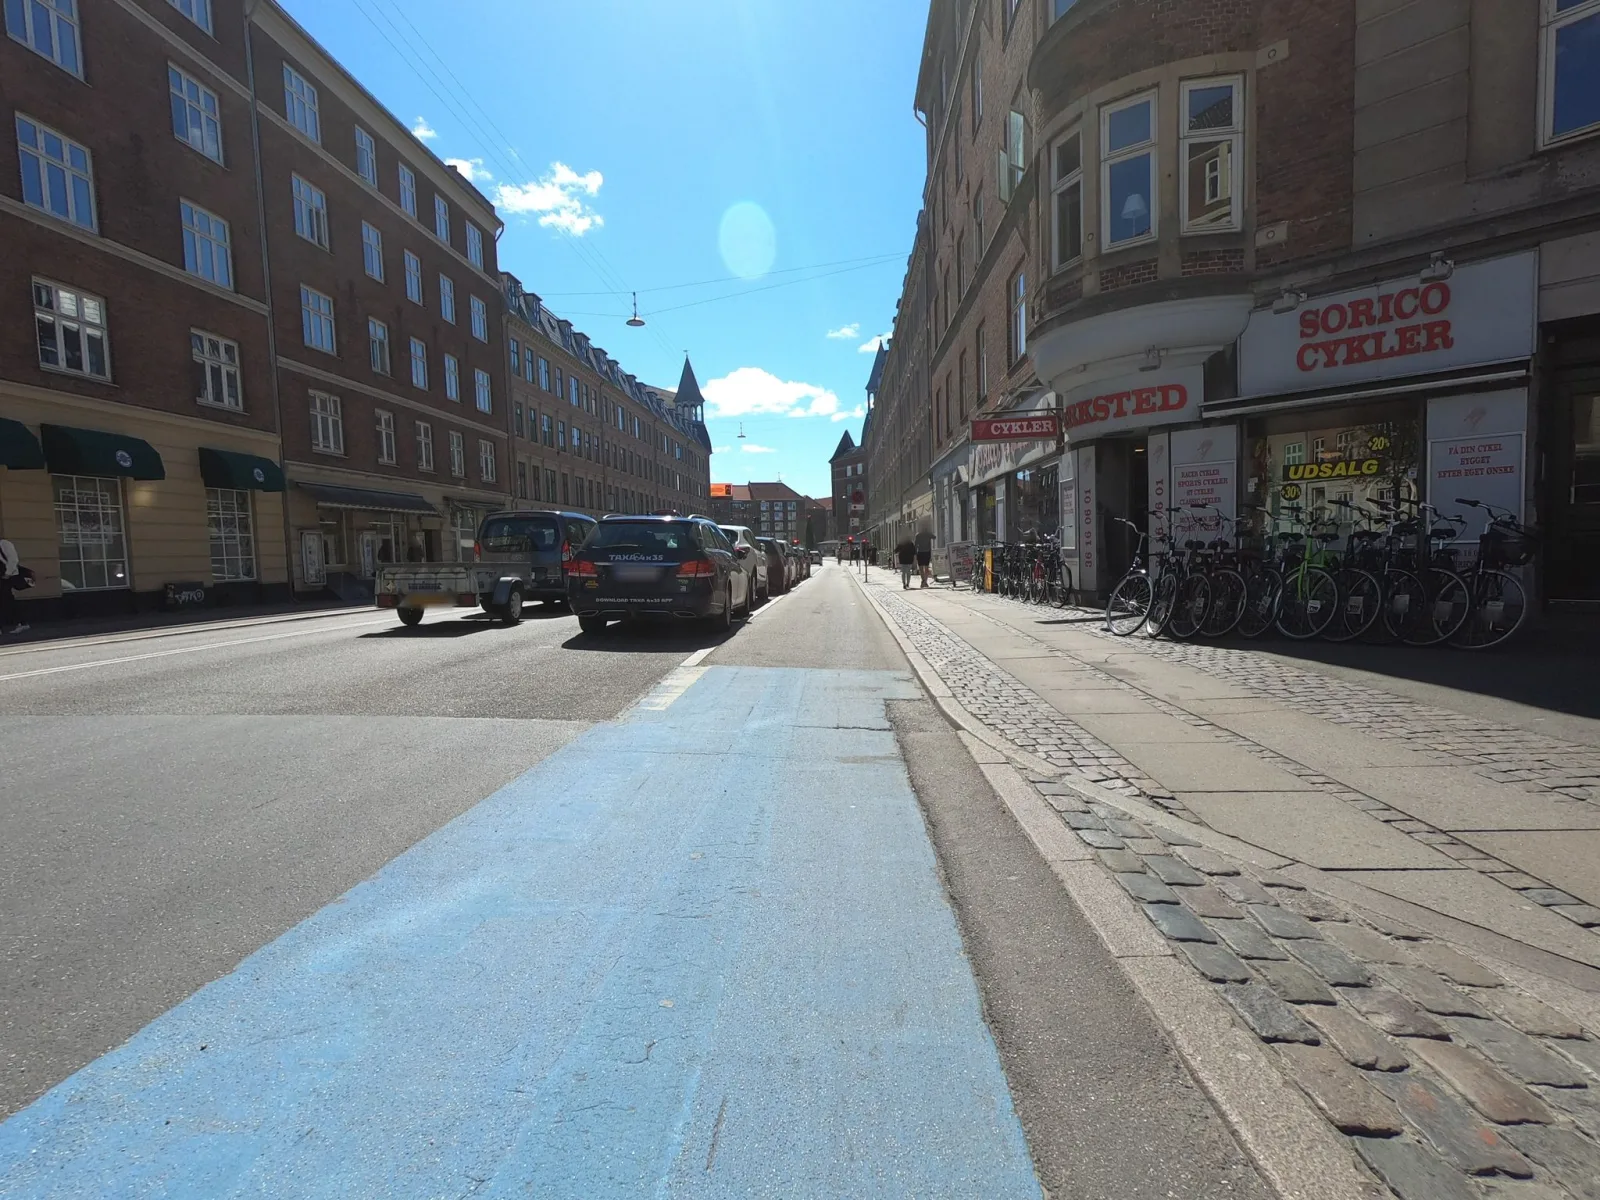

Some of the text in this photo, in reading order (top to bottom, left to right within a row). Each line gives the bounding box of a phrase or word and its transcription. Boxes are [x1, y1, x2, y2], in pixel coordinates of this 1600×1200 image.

[1299, 281, 1451, 338] SORICO
[1296, 319, 1454, 372] CYKLER
[990, 420, 1053, 435] CYKLER
[1460, 445, 1476, 454] DIN
[1477, 443, 1503, 453] CYKEL
[1460, 456, 1491, 465] BYGGET
[1181, 469, 1220, 478] RACER CYKLER
[1288, 458, 1379, 480] UDSALG
[1438, 470, 1462, 478] EFTER
[1464, 468, 1484, 476] EGET
[1155, 479, 1164, 496] 01
[1177, 478, 1229, 487] SPORTS CYKLER
[1084, 489, 1092, 504] 01
[1085, 531, 1092, 546] 16
[1085, 552, 1092, 568] 36
